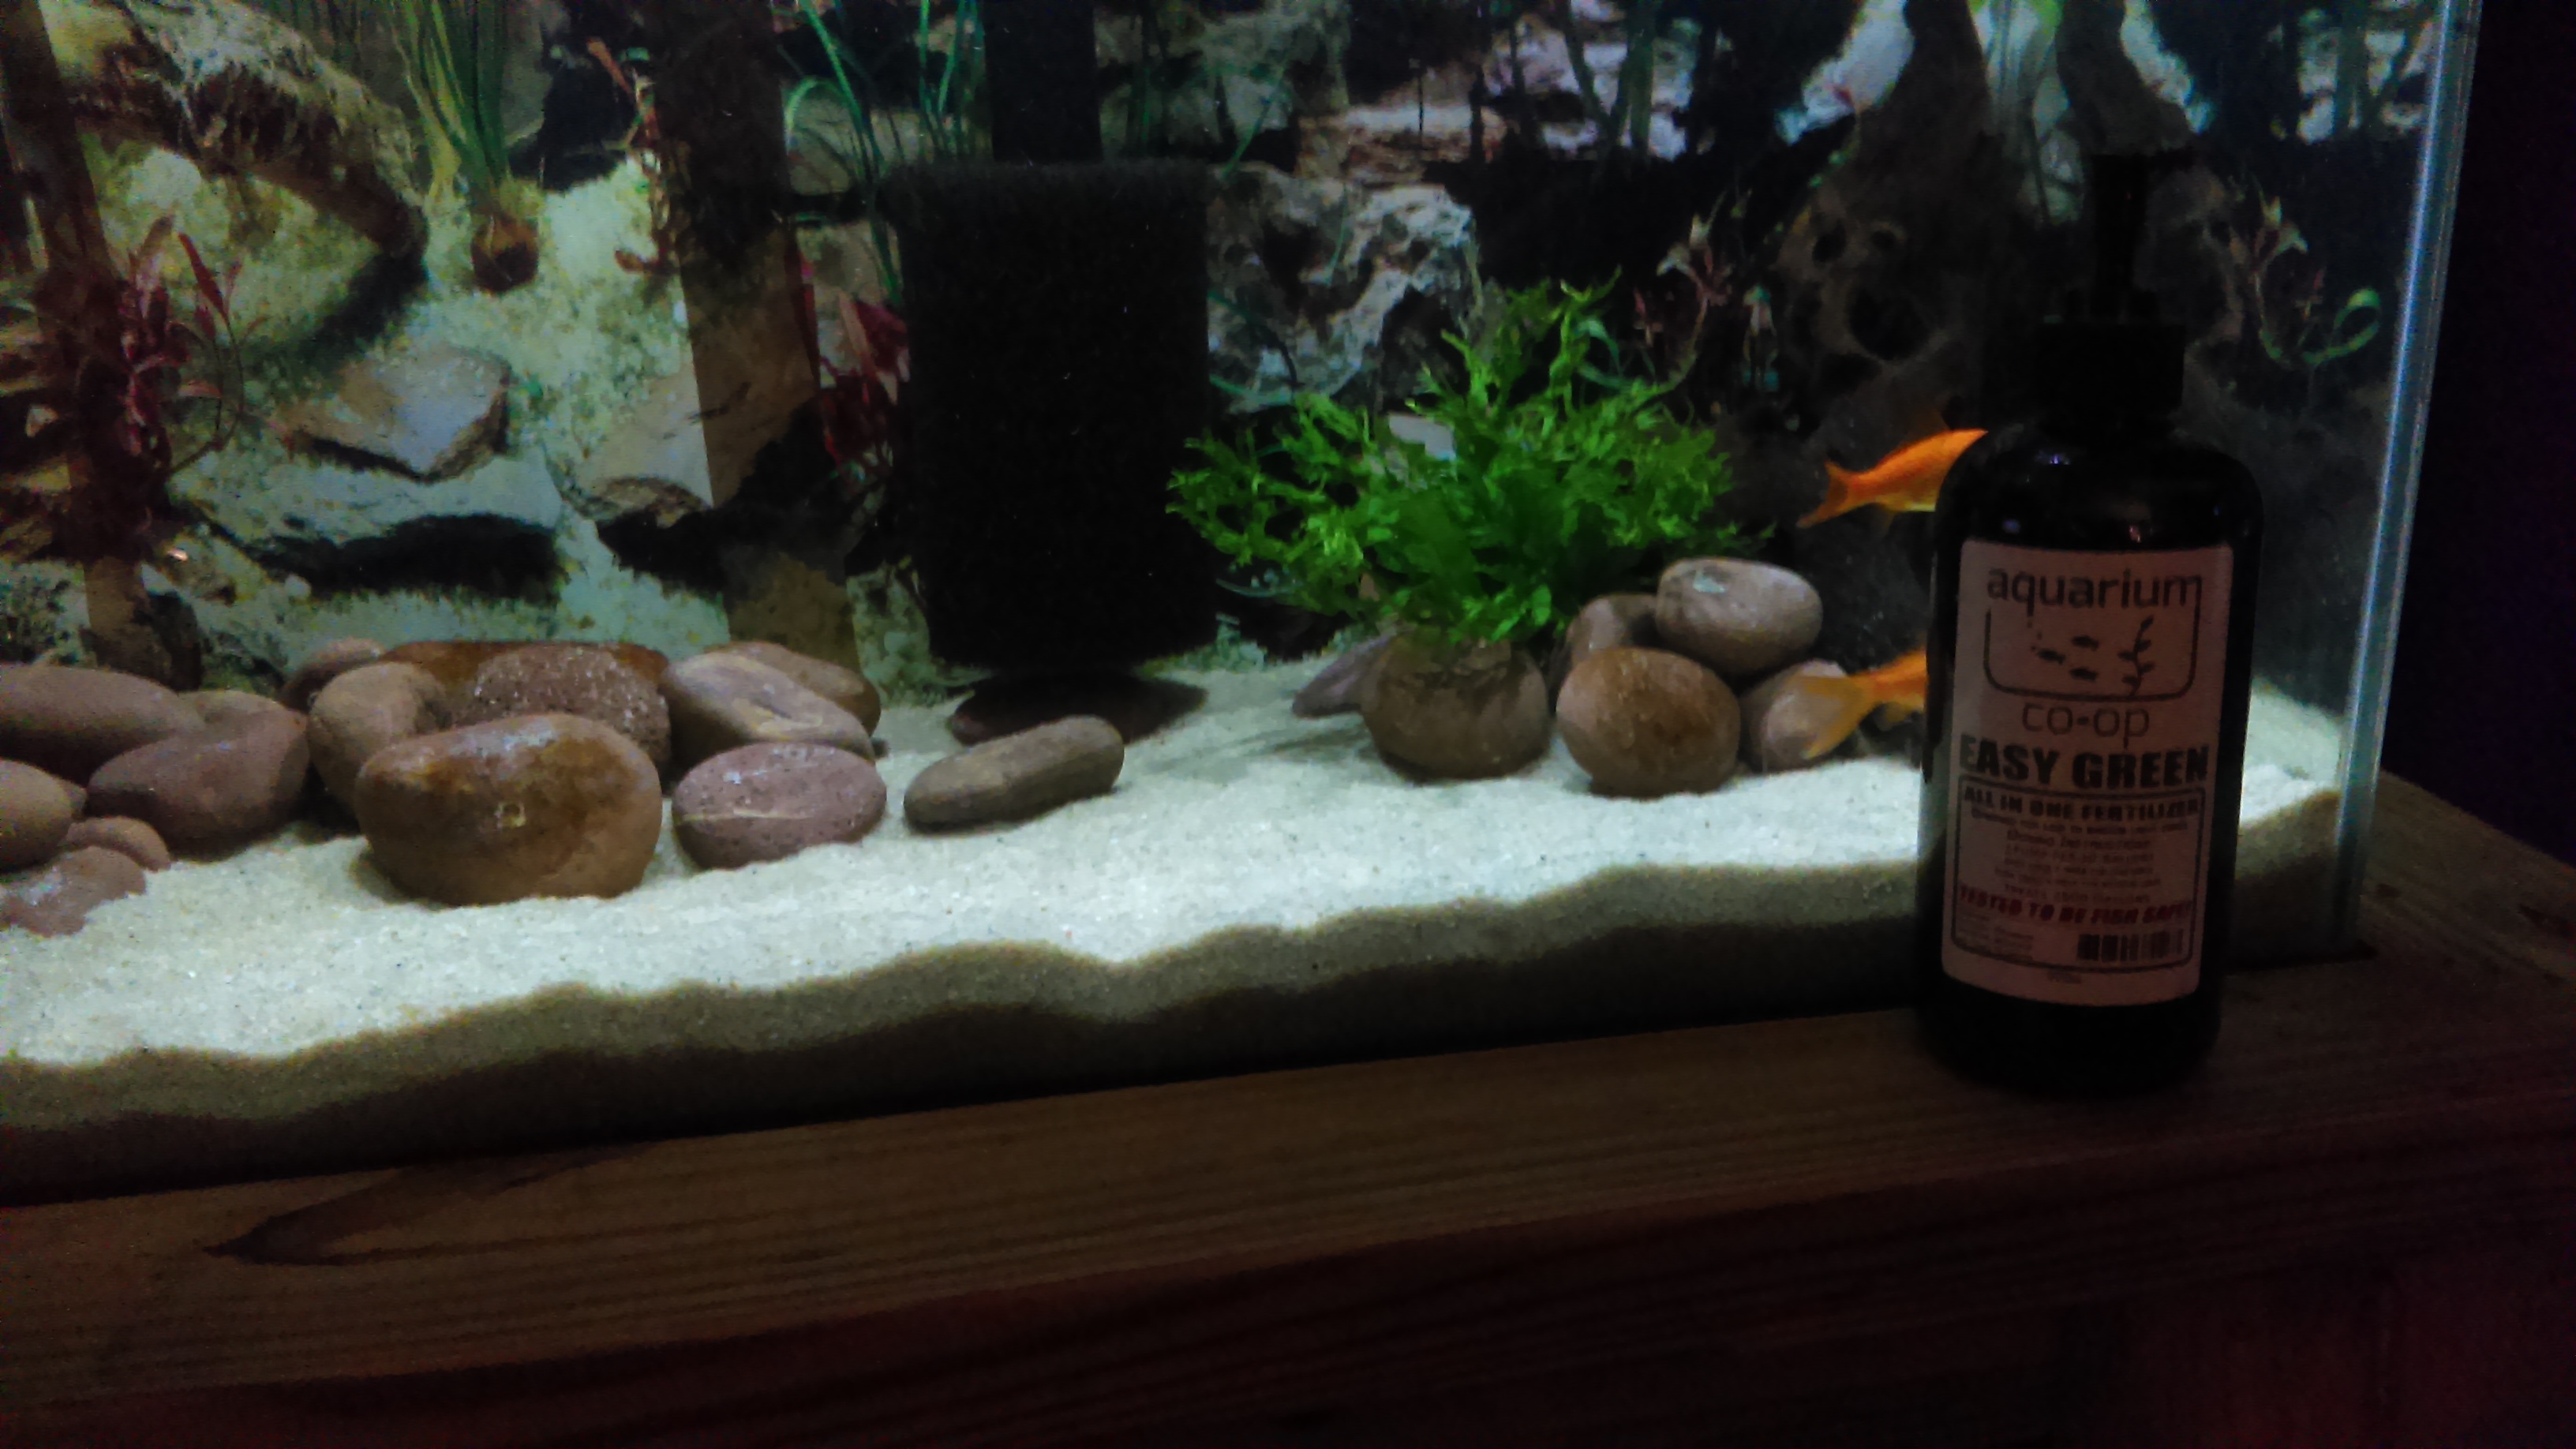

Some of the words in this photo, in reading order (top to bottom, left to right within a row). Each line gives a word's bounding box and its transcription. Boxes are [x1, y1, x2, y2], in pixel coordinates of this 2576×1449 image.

[1987, 567, 2202, 616] aquarium
[2022, 703, 2150, 749] co-op
[1960, 734, 2058, 784] EASY
[2072, 746, 2209, 789] GREEN
[1964, 785, 1993, 805] ALL
[2000, 794, 2023, 813] IN
[2030, 799, 2072, 819] ONE
[1960, 884, 2023, 916] TESTED
[2029, 902, 2055, 922] TO
[2058, 907, 2088, 924] BE
[2091, 908, 2140, 925] FISH
